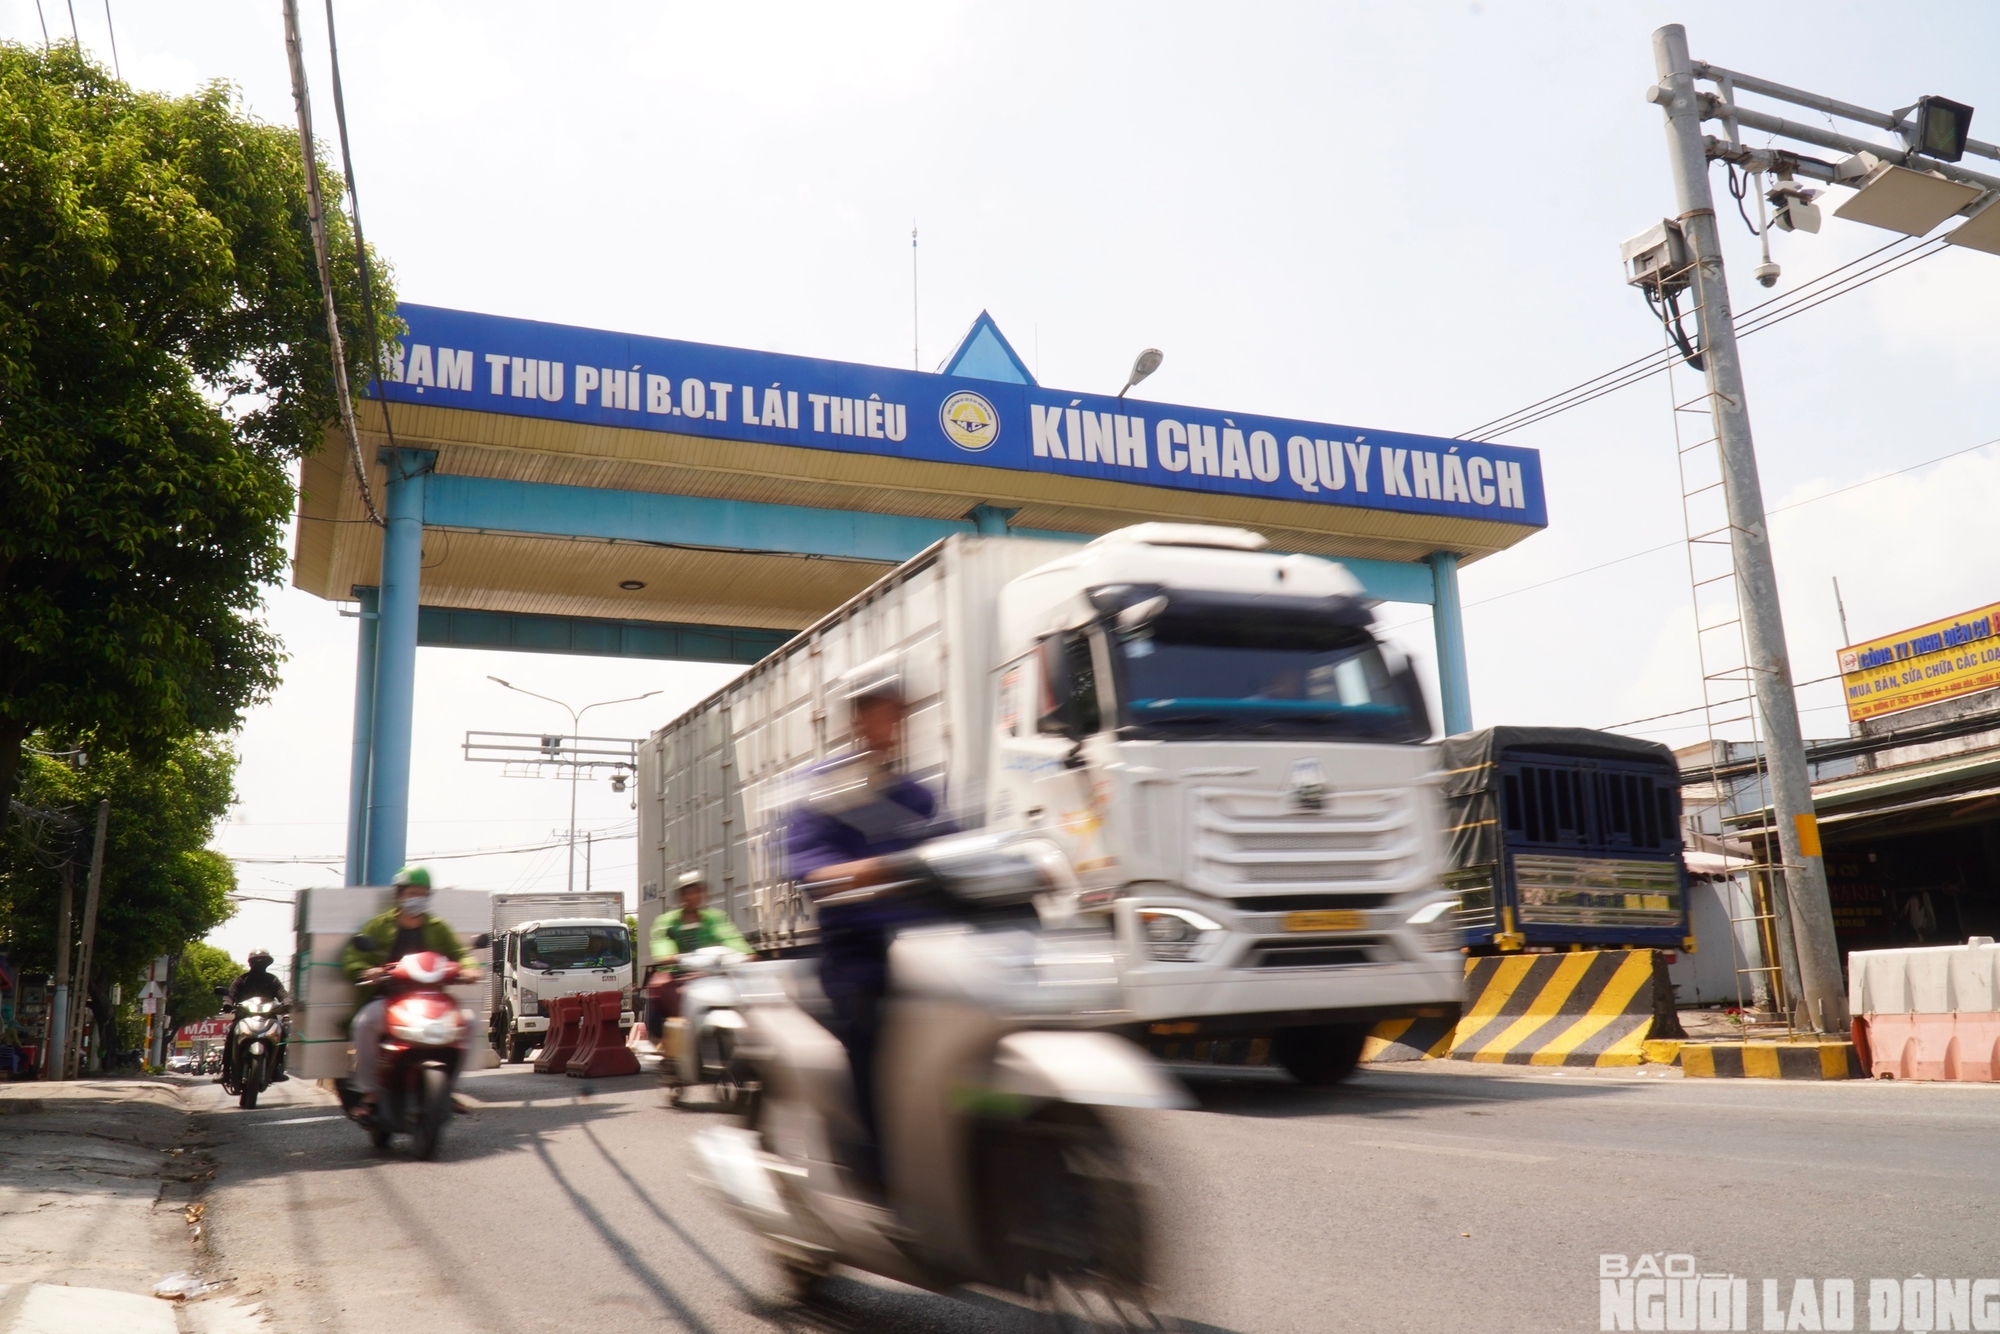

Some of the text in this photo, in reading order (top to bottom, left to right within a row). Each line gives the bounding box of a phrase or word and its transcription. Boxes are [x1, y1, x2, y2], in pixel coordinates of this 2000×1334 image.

[372, 339, 474, 394] RẠM
[485, 353, 564, 402] THU
[575, 364, 641, 411] PHÍ
[646, 373, 733, 421] B.O.T
[741, 382, 799, 430] LÁI
[808, 393, 908, 442] THIÊU
[1029, 399, 1149, 469] KÍNH
[1156, 418, 1281, 483] CHÀO
[1287, 435, 1370, 493] QUÝ
[1380, 446, 1526, 510] KHÁCH
[1848, 645, 2000, 699] MUA BÁN, SỬA CHỮA CÁC LOẠ
[1860, 647, 1893, 669] CÔNG
[1894, 641, 1909, 660] TY
[1909, 632, 1942, 655] TNHH
